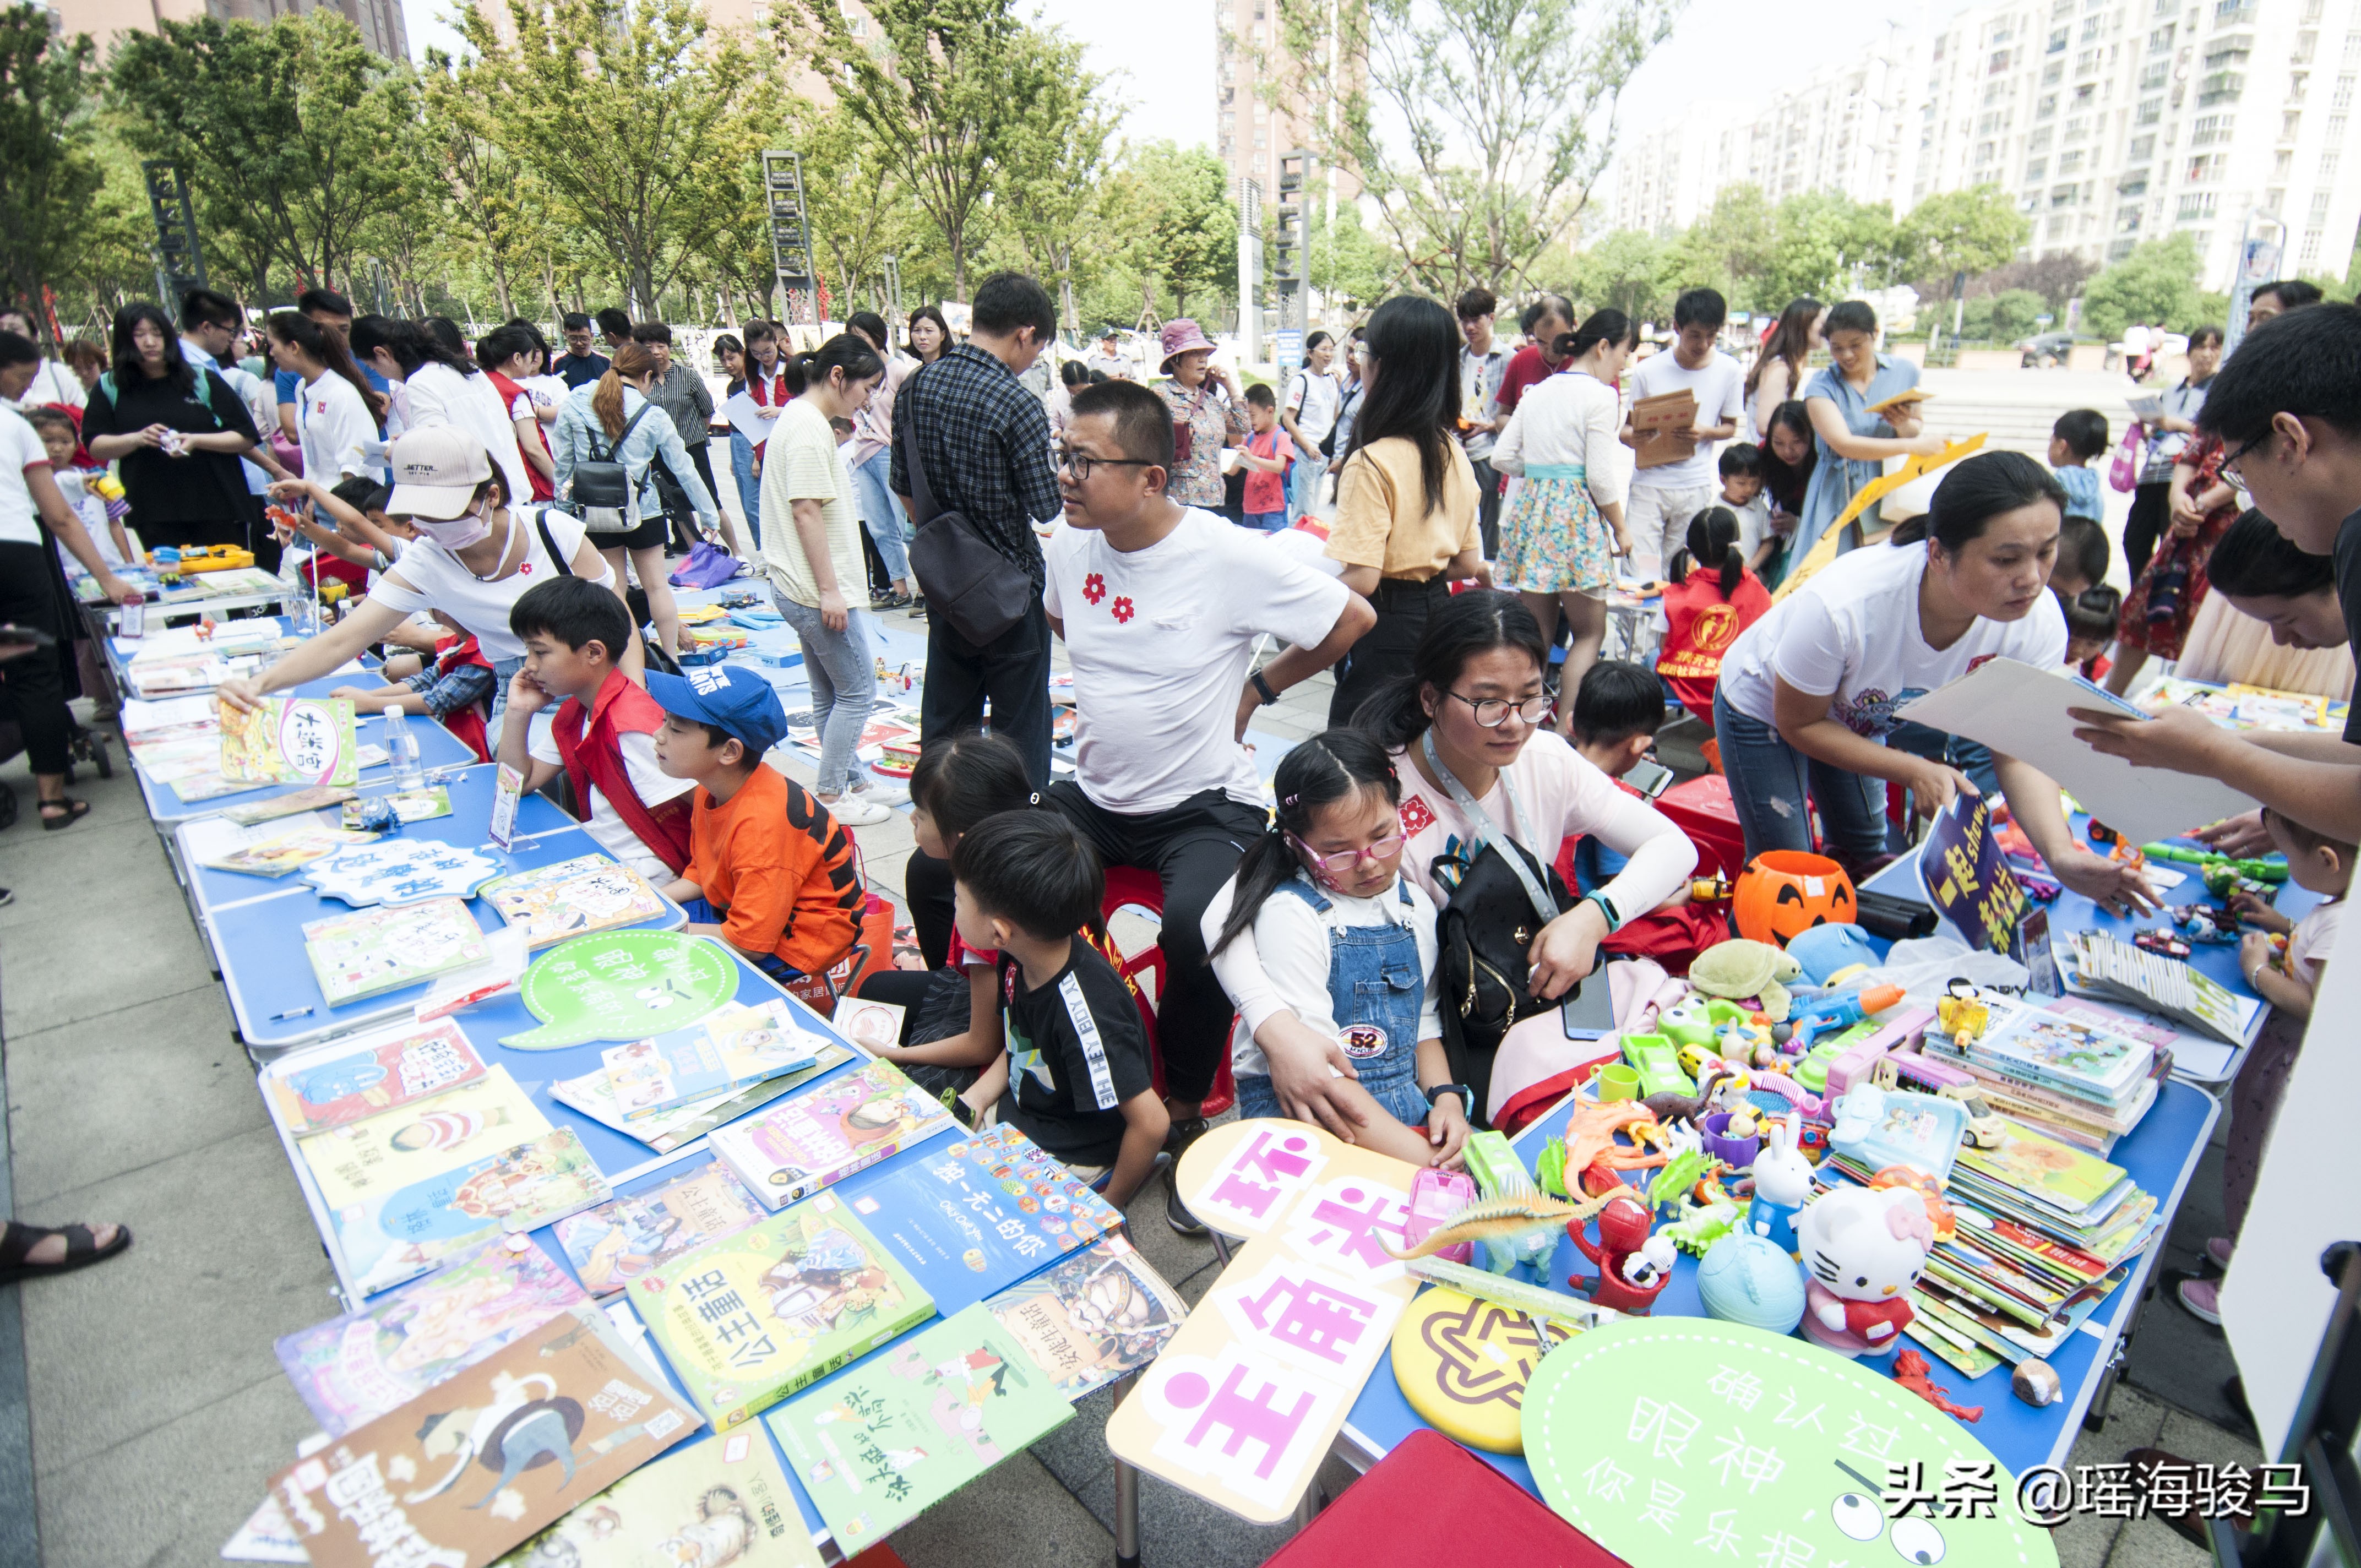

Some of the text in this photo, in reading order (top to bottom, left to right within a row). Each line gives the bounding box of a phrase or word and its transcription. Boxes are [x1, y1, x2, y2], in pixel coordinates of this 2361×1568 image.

[293, 711, 322, 771] 大迷宫
[591, 948, 651, 982] 眼神
[1351, 1032, 1377, 1048] 52
[771, 1103, 850, 1165] 格林童话
[838, 1151, 883, 1178] 格林童话
[681, 1184, 728, 1234] 公主童话
[932, 1158, 1048, 1260] 独一无二的你
[681, 1267, 779, 1370] 公主童话
[1019, 1302, 1078, 1371] 安徒生童话
[776, 1353, 842, 1401] 公主童话
[854, 1384, 895, 1431] 不高兴
[1627, 1395, 1787, 1495] 眼神
[748, 1470, 786, 1539] 奇怪的小客人
[1581, 1455, 1870, 1568] 你是乐捐
